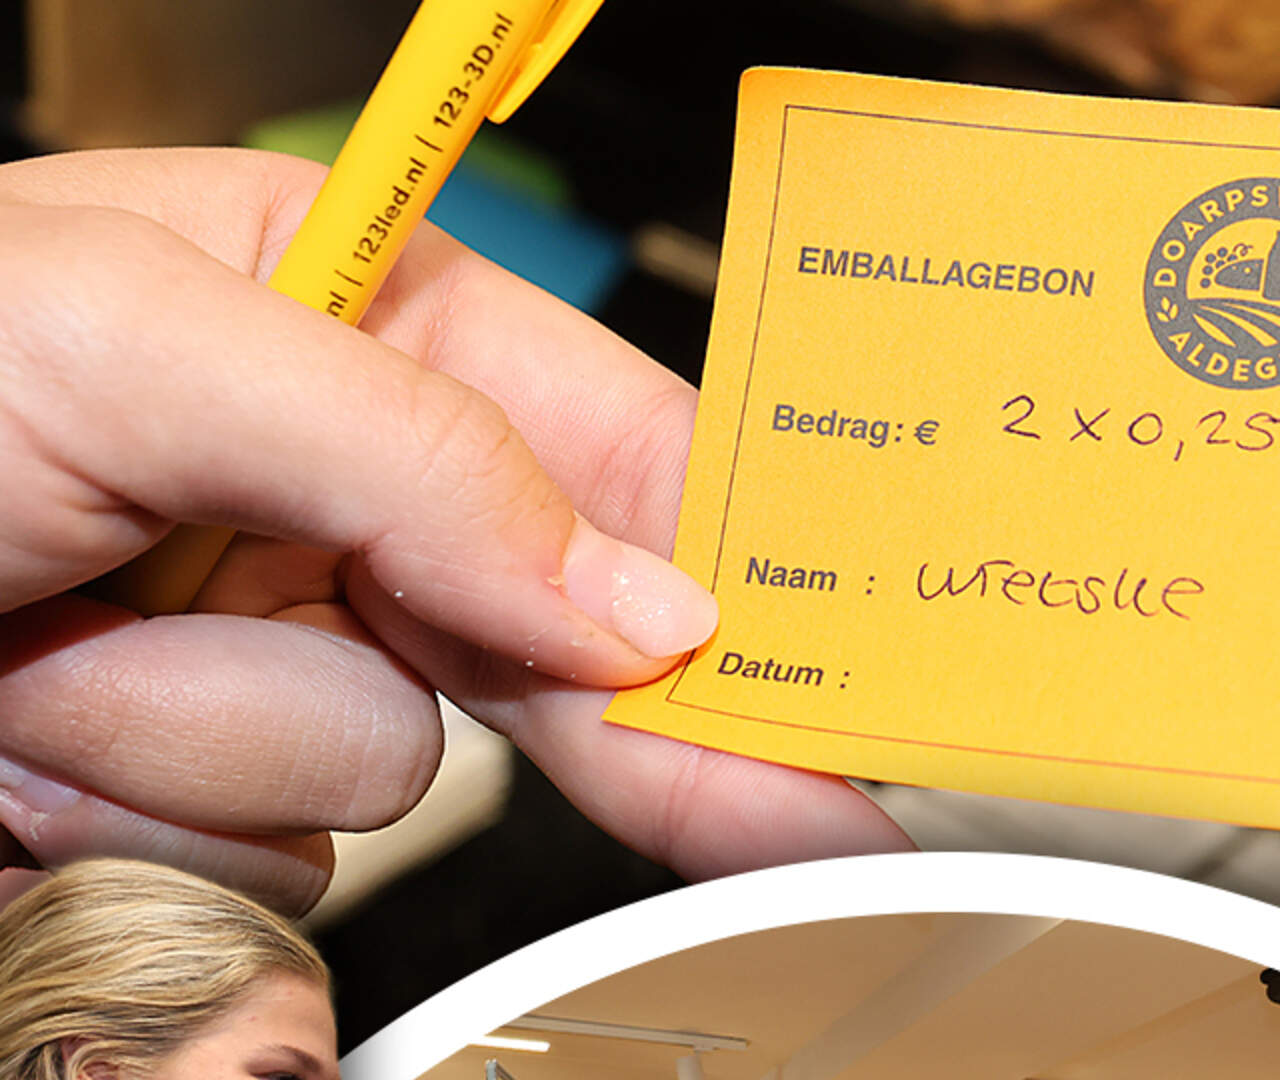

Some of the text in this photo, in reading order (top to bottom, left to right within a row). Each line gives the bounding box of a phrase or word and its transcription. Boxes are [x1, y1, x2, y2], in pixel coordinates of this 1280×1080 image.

[326, 290, 348, 317] nl
[353, 157, 427, 264] 123led.nl
[433, 12, 514, 129] 123-3D.nl
[798, 246, 1095, 297] EMBALLAGEBON
[913, 420, 940, 445] €
[1002, 395, 1041, 440] 2
[745, 556, 838, 592] Naam
[717, 651, 824, 687] Datum
